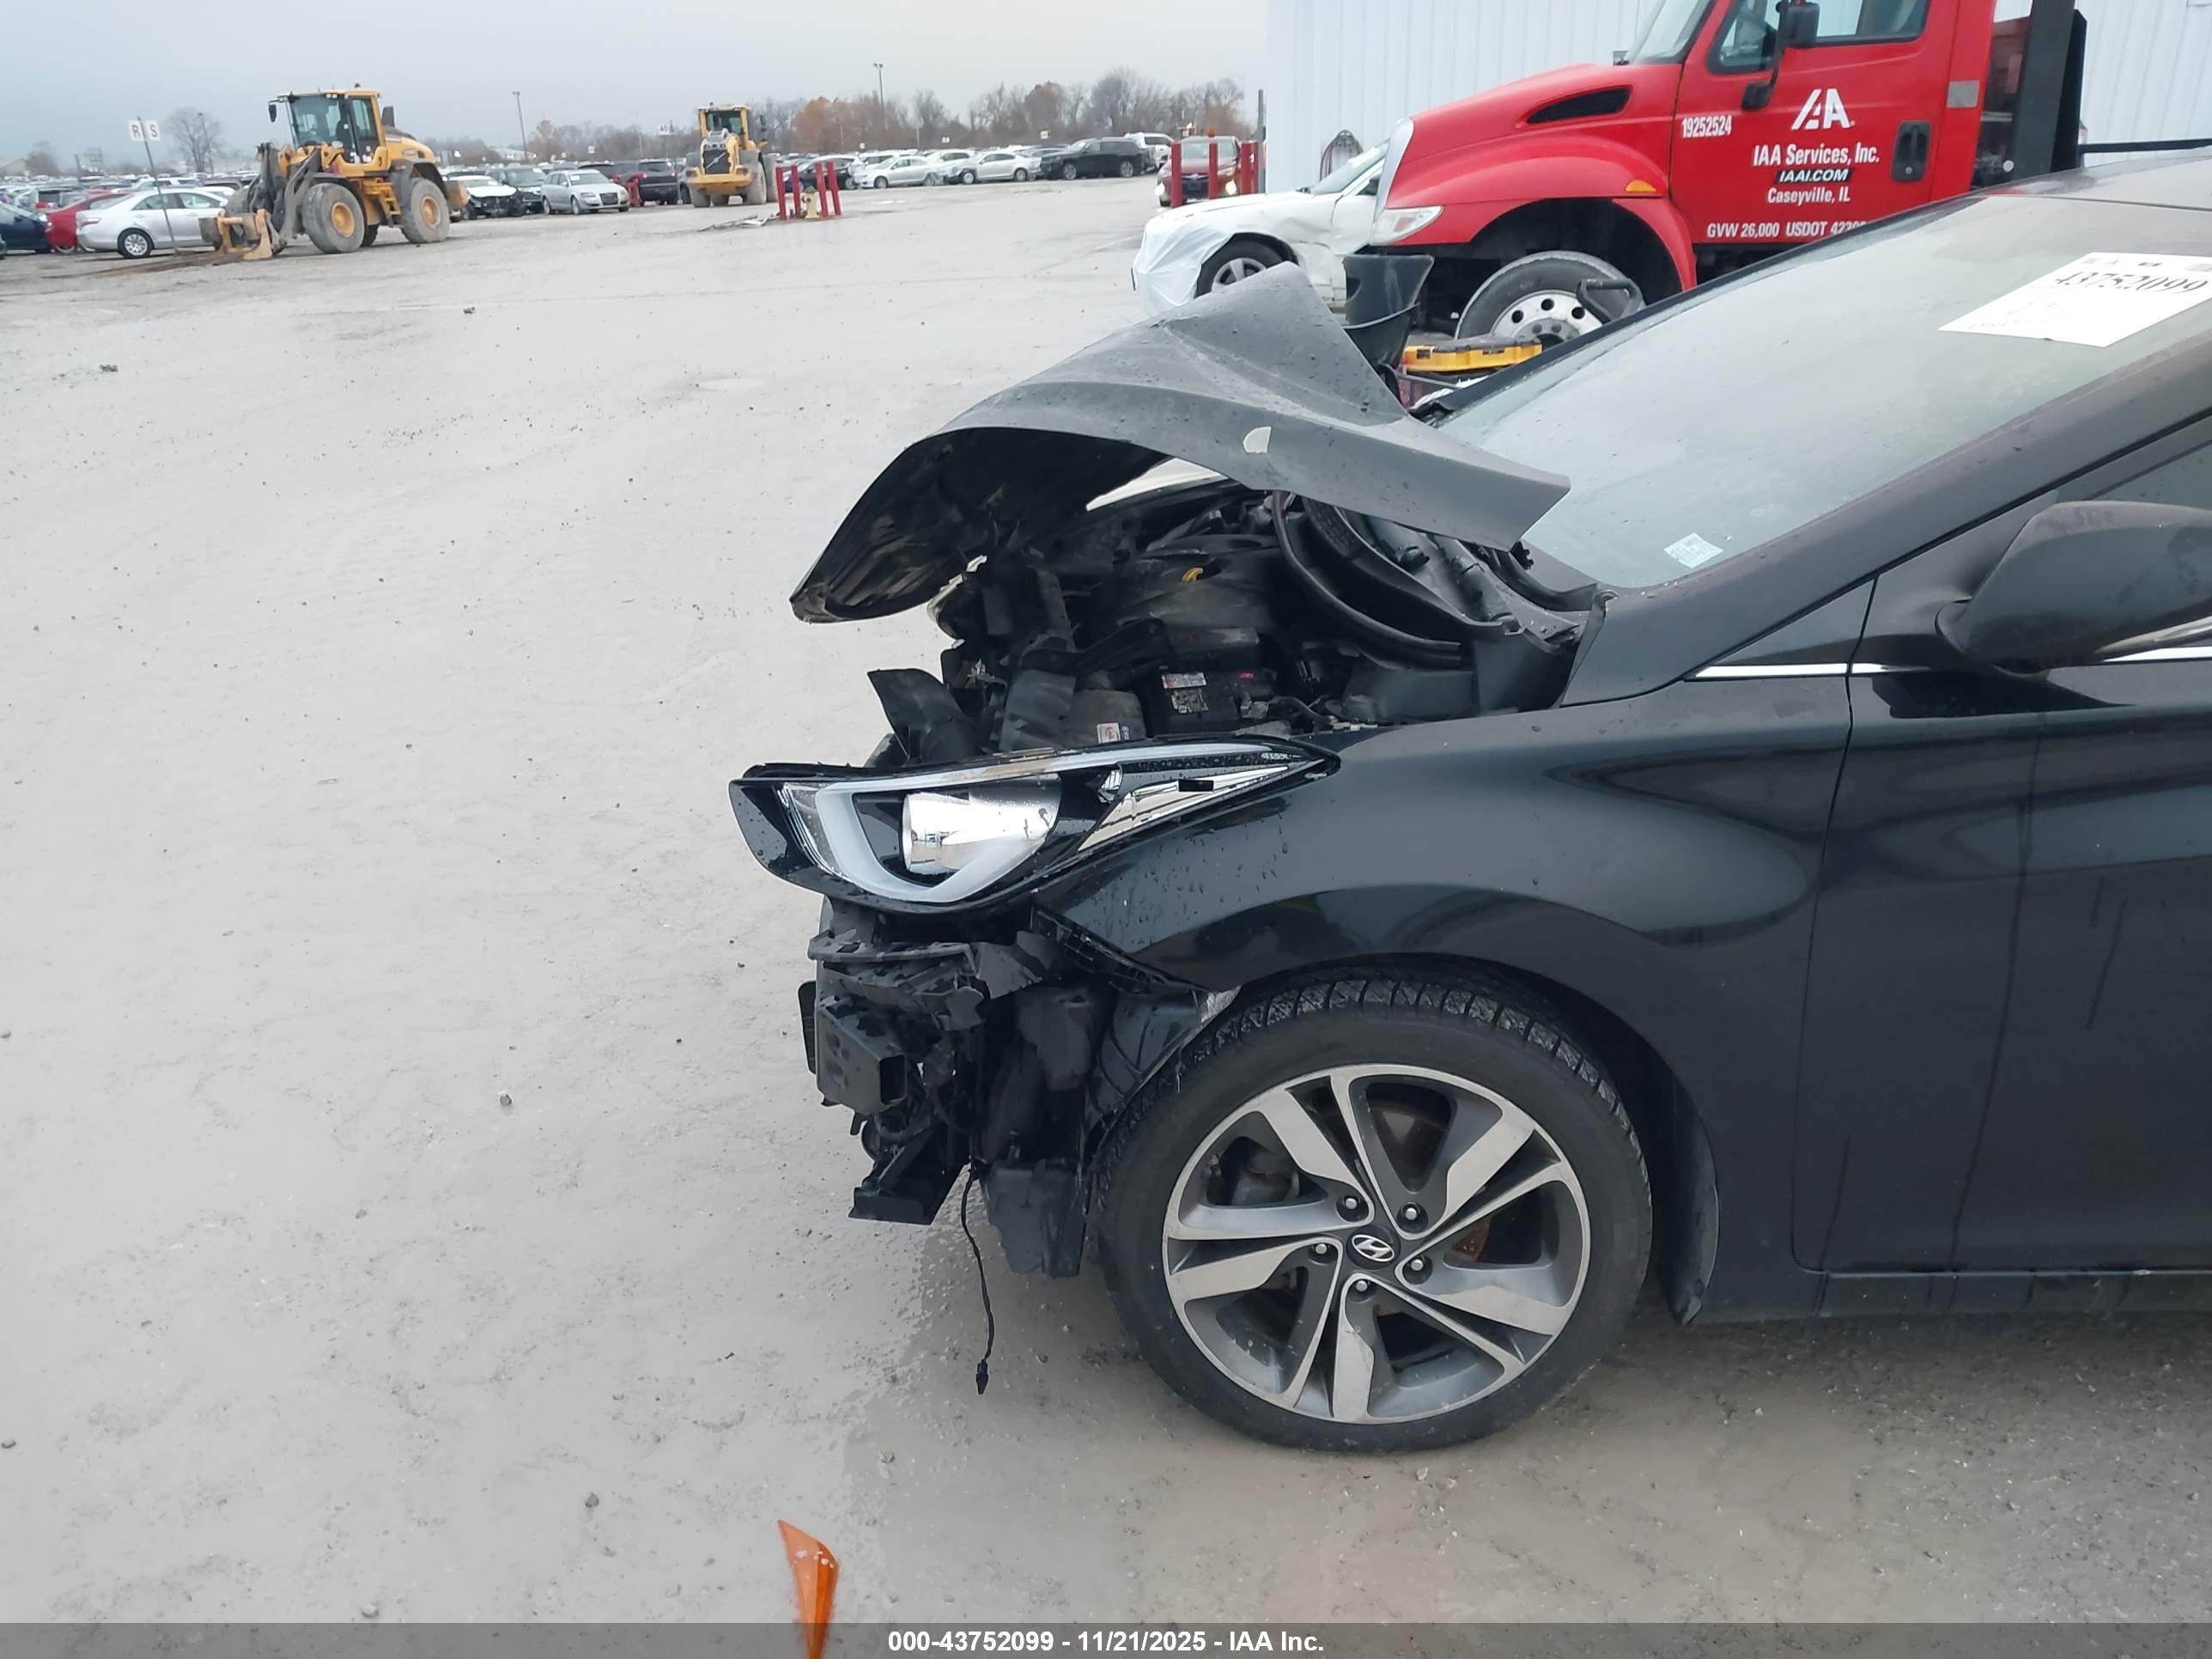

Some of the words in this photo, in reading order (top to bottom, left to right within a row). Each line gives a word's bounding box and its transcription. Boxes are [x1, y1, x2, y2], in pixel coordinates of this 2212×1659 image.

[131, 124, 141, 138] R
[150, 124, 159, 138] S
[1682, 116, 1732, 137] 19252524
[1753, 144, 1781, 166] IAA
[1785, 143, 1851, 166] Services,
[1855, 142, 1880, 163] Inc.
[1779, 169, 1849, 183] IAAI.COM
[1767, 186, 1836, 206] Caseyville,
[1838, 186, 1850, 202] IL
[1707, 222, 1739, 238] GVW
[1741, 222, 1779, 239] 26,000
[1786, 221, 1828, 236] USDOT
